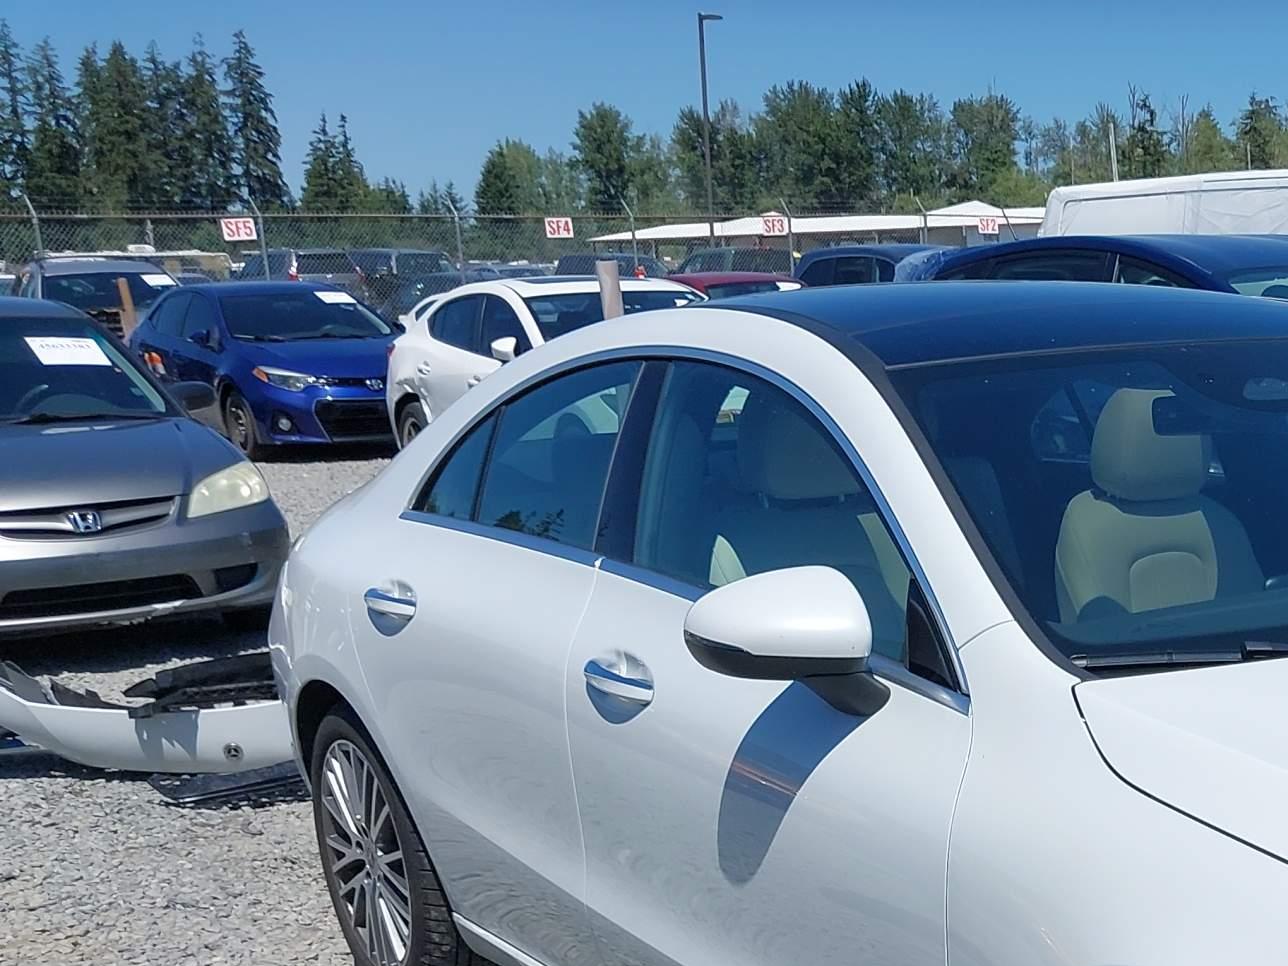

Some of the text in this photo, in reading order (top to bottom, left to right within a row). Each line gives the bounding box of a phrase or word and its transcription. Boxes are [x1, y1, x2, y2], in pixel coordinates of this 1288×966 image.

[223, 220, 253, 238] SF5
[547, 220, 571, 236] SF4
[763, 219, 785, 233] SF3
[979, 218, 997, 232] SF2
